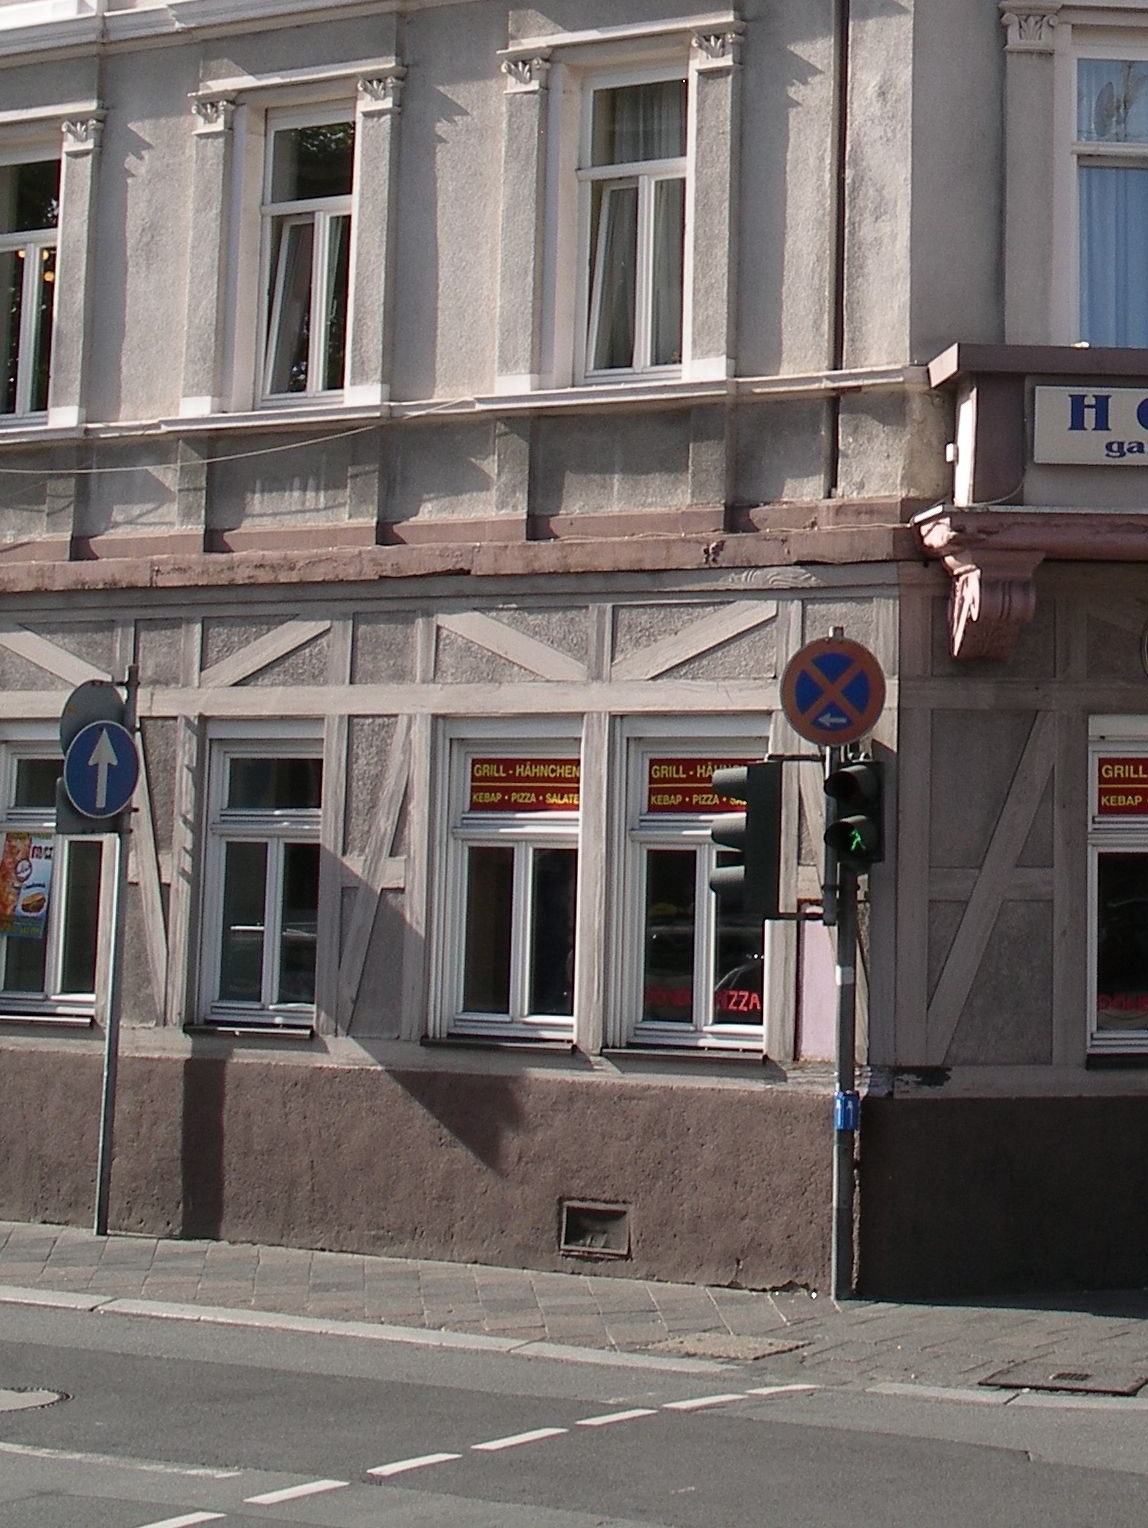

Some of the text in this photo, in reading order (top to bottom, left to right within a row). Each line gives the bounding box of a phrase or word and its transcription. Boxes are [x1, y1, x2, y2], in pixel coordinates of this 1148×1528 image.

[474, 762, 580, 778] GRILL HÄHNCHEN
[651, 765, 686, 778] GRILL
[1102, 765, 1147, 778] GRILL
[473, 793, 579, 804] KEBAP PIZZA SALATE
[651, 794, 682, 805] KEBAP
[692, 794, 719, 805] PIZZA
[1101, 796, 1142, 806] KEBAP
